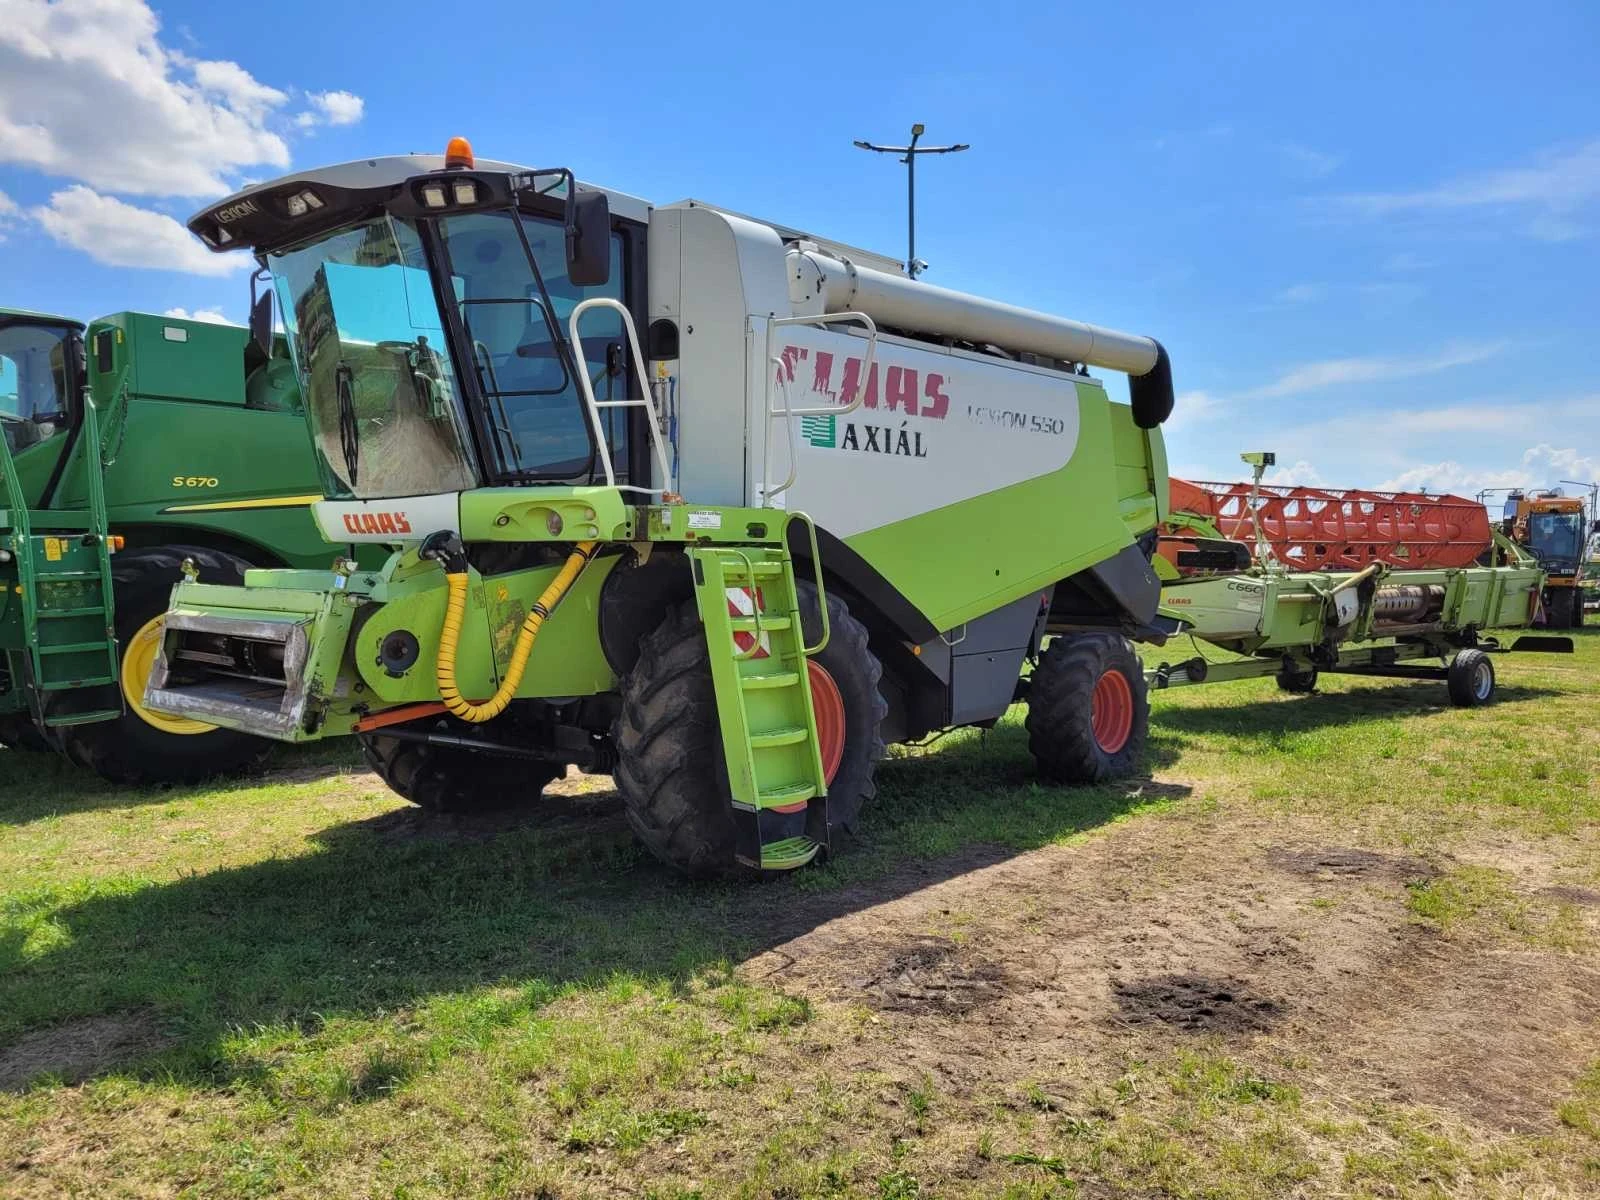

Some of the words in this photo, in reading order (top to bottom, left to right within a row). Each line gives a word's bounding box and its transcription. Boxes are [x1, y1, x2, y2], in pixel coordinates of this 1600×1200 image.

[214, 200, 258, 224] LEXION
[841, 420, 928, 458] AXIÁL
[172, 476, 185, 487] S
[186, 477, 219, 488] 670
[343, 512, 412, 534] CLAAS
